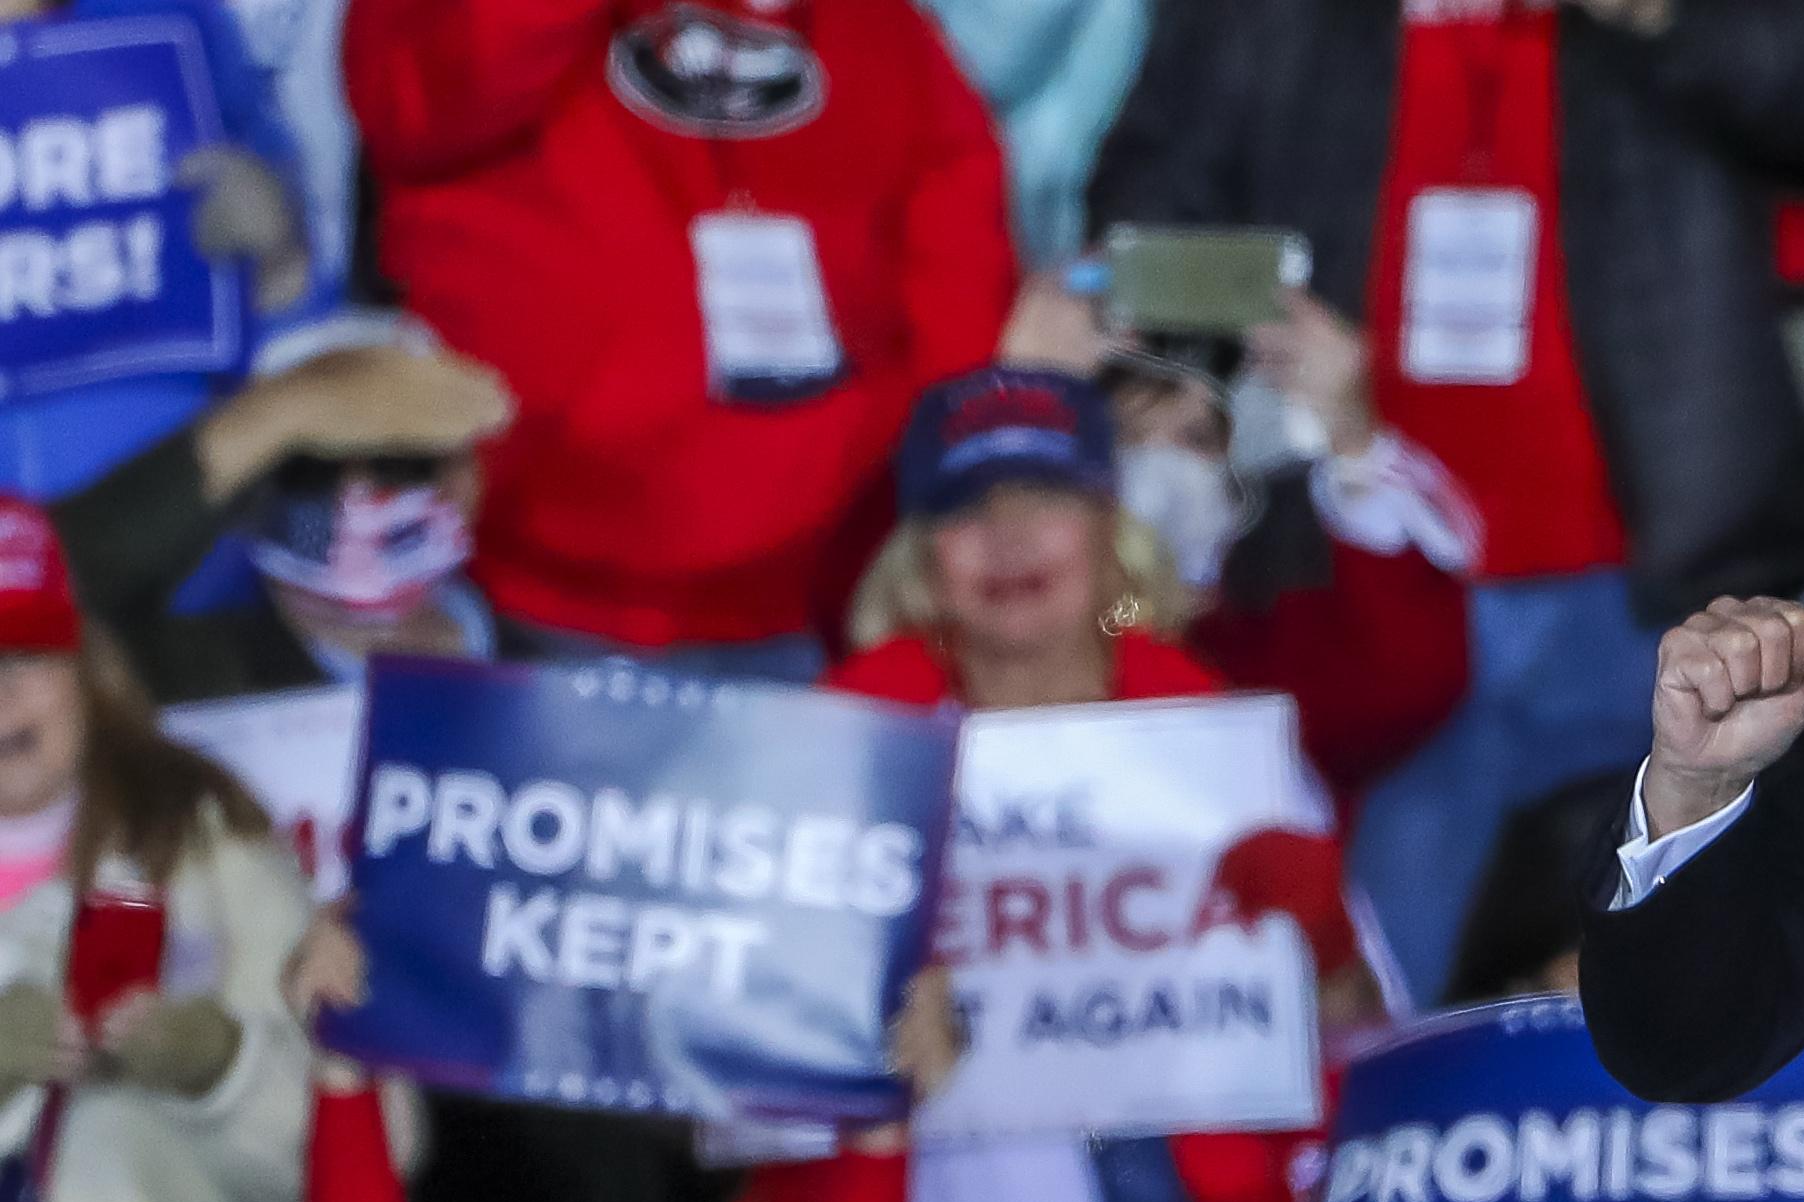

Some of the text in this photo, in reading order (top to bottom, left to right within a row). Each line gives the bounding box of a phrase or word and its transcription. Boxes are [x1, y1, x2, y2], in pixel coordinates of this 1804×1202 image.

[0, 103, 167, 212] RE
[363, 763, 925, 917] PROMISES
[482, 881, 771, 1002] KEPT
[1019, 975, 1275, 1050] AGAIN
